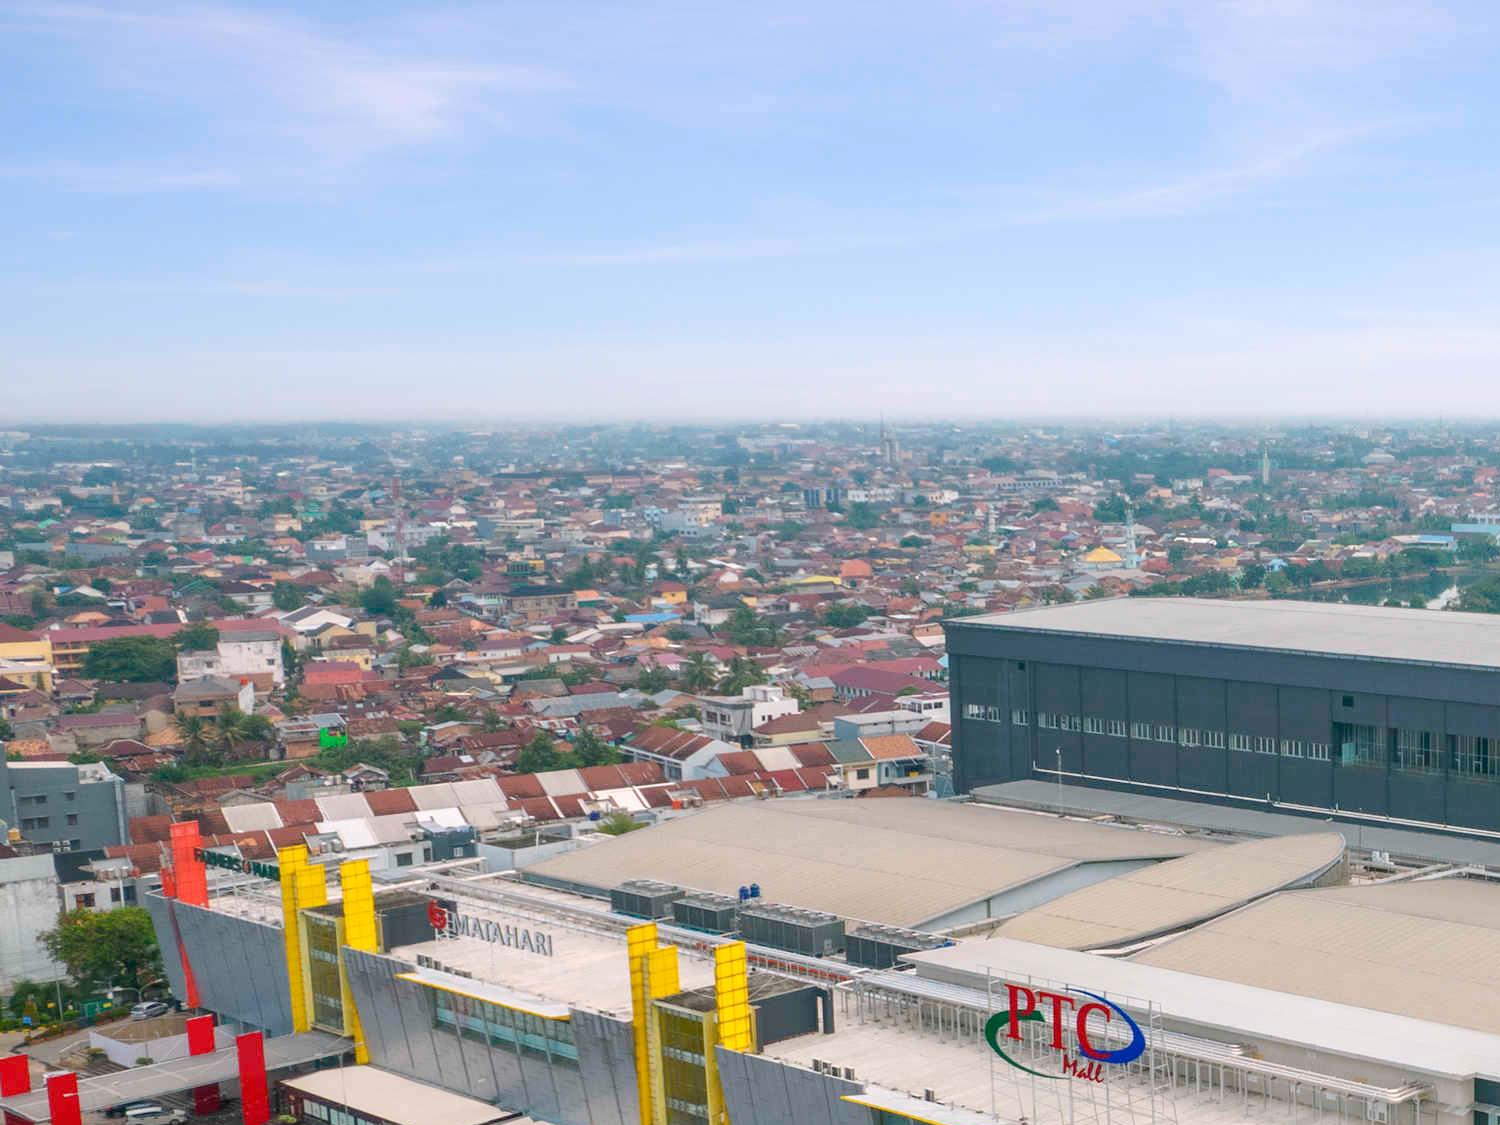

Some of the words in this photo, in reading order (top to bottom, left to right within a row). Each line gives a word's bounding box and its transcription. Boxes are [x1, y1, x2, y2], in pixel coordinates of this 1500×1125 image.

[453, 913, 553, 956] MATAHARI
[1004, 983, 1113, 1060] PTC
[1063, 1054, 1105, 1083] Mall
